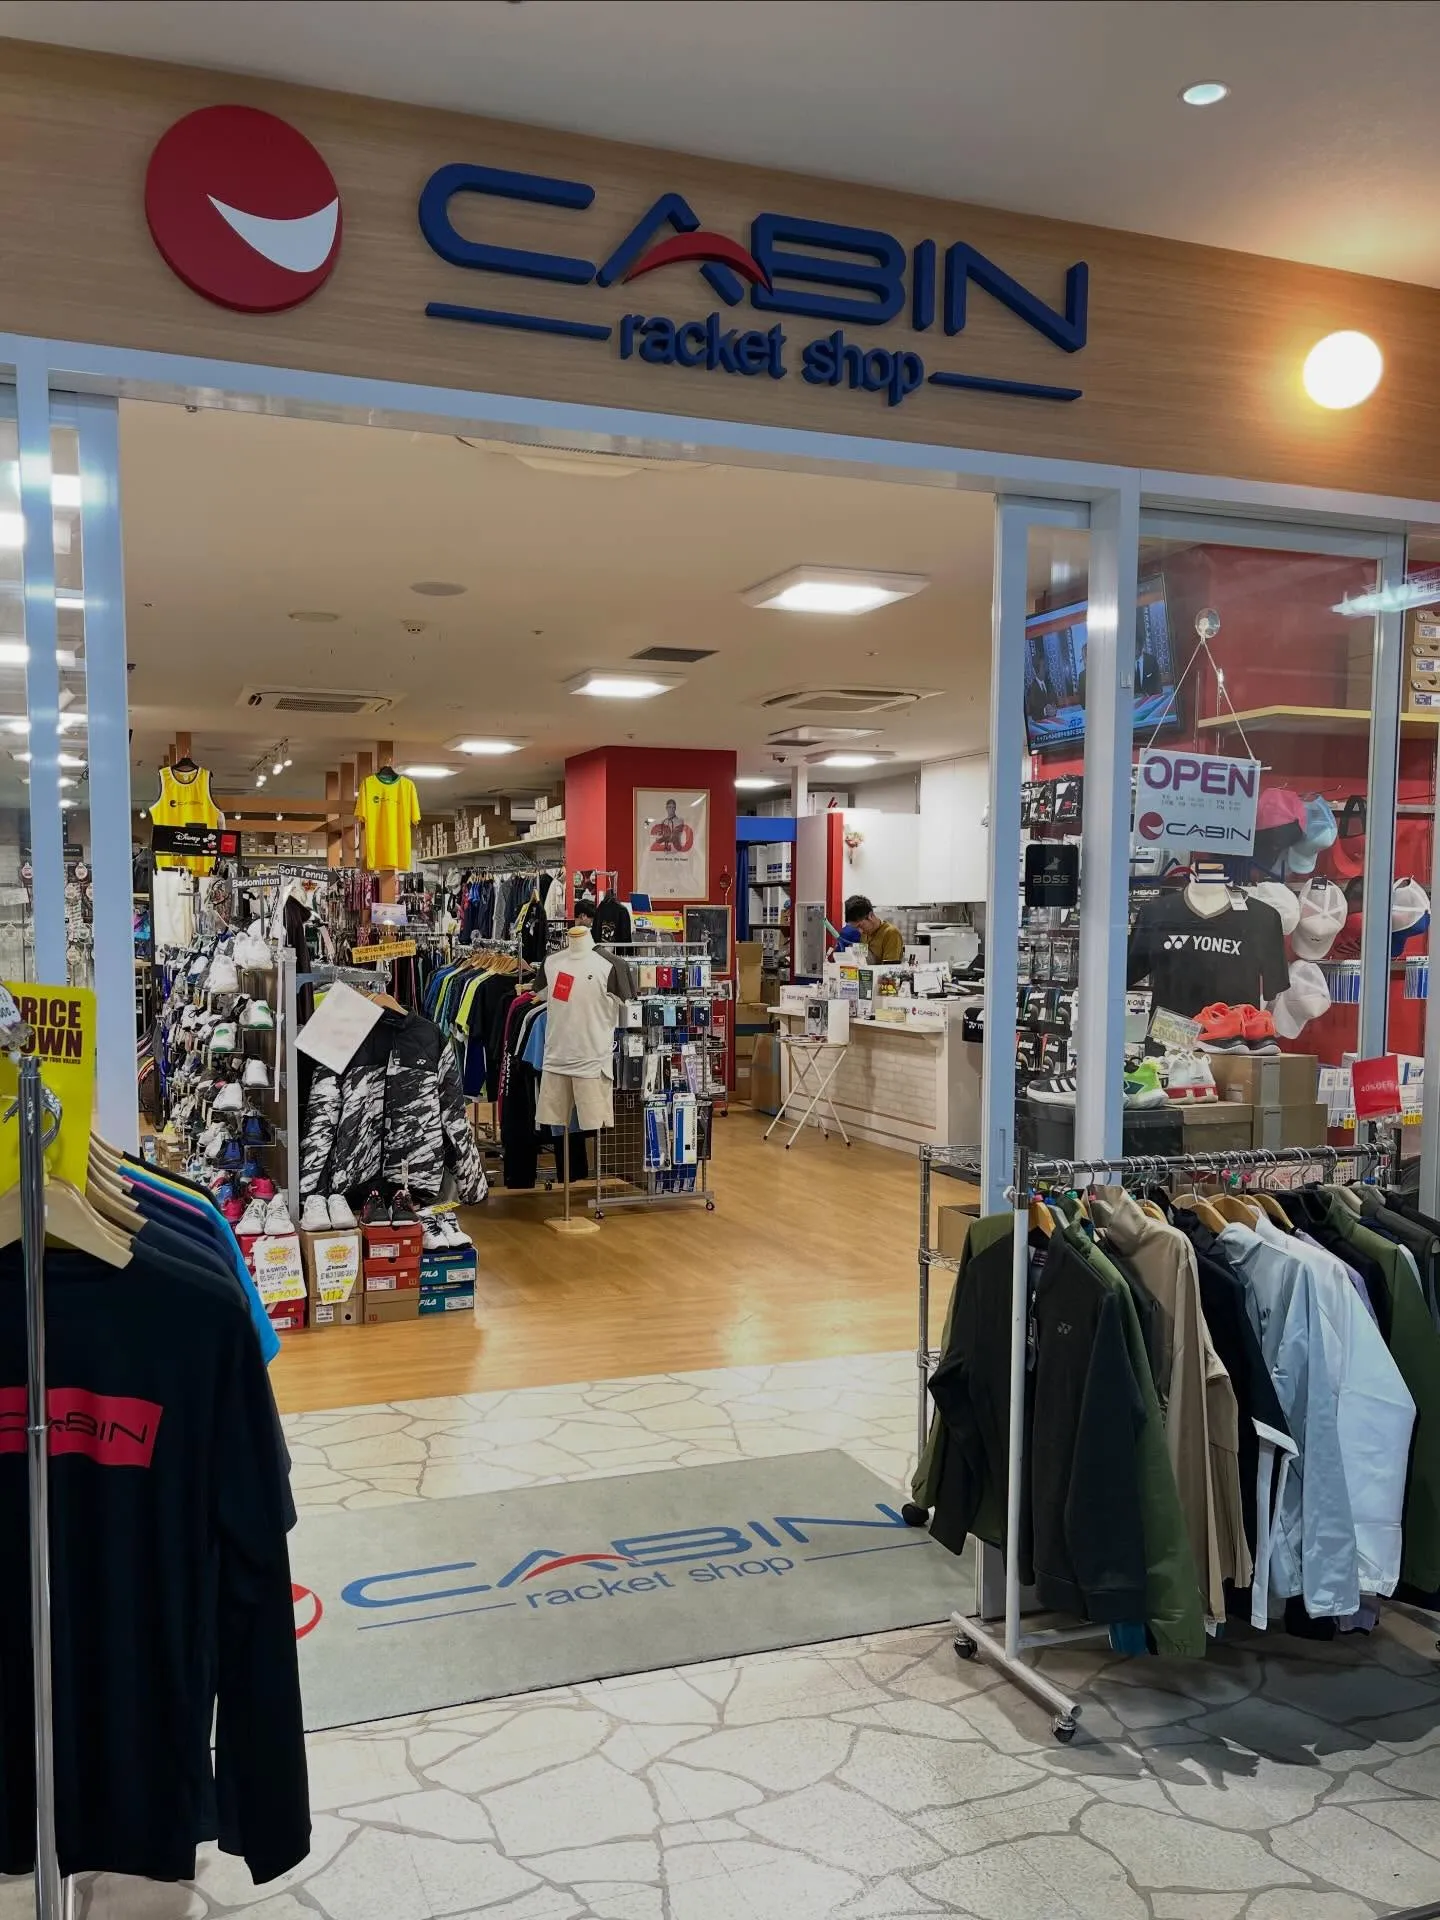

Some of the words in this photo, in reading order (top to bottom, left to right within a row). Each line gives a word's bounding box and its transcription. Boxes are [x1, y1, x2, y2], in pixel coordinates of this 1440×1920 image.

[418, 162, 1089, 353] CABIN
[619, 312, 787, 379] racket
[801, 330, 924, 407] shop
[1144, 756, 1255, 798] OPEN
[650, 823, 694, 853] 20
[1166, 822, 1251, 841] CABIN
[279, 865, 297, 876] Soft
[300, 868, 328, 881] Tennis
[1032, 874, 1070, 884] BOSS
[1192, 935, 1242, 956] YONEX
[420, 1270, 439, 1278] FILA
[419, 1299, 437, 1307] FILA
[340, 1503, 909, 1609] CABIN
[526, 1571, 675, 1609] racket
[693, 1553, 795, 1583] shop
